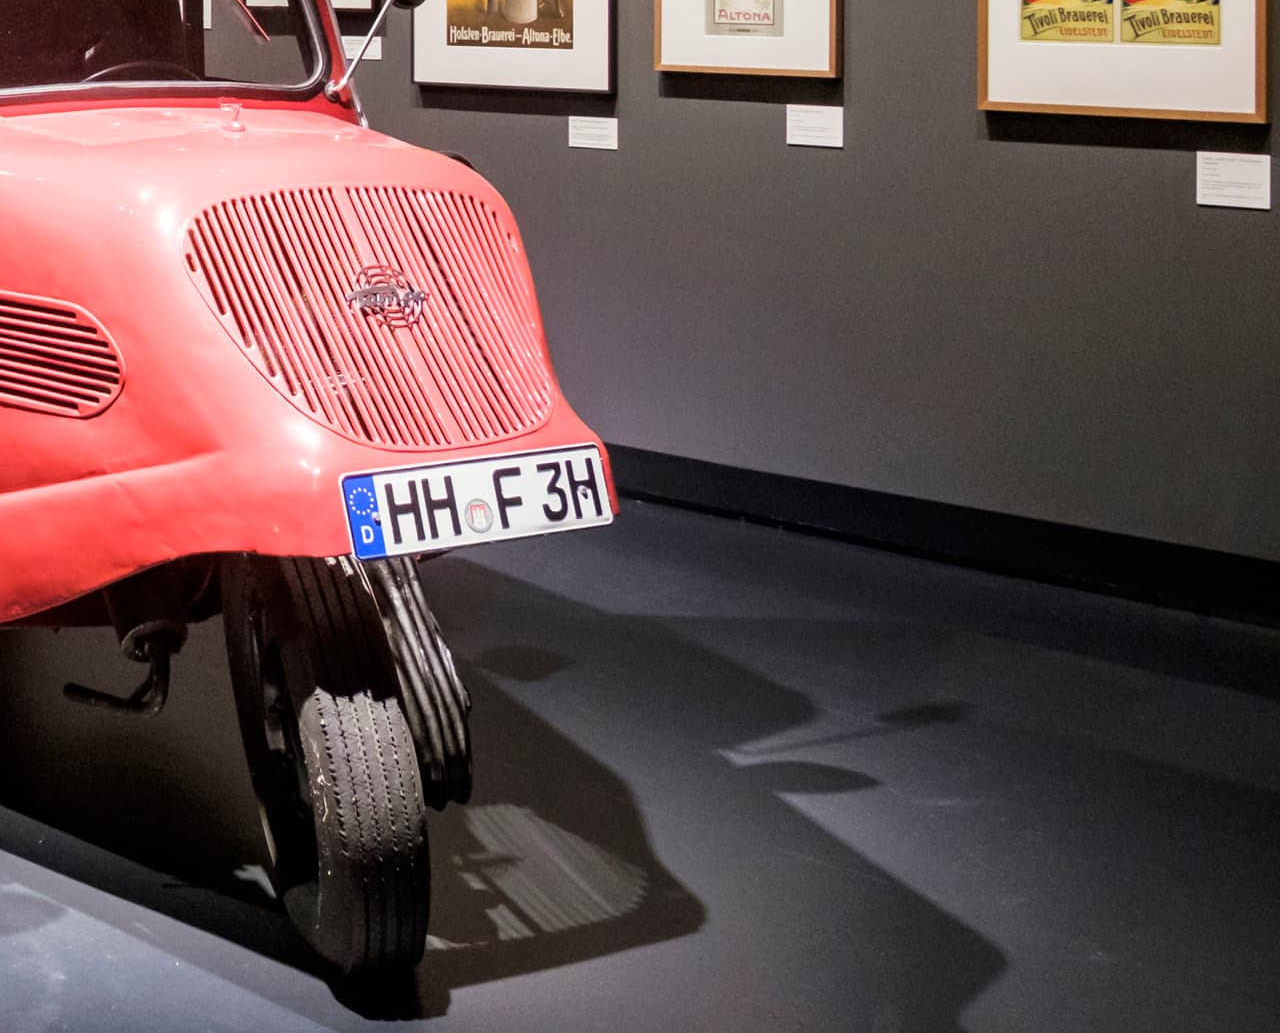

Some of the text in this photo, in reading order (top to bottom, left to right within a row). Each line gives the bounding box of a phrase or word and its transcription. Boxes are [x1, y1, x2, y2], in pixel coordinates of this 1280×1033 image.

[718, 9, 770, 22] ALTONA
[1024, 7, 1109, 36] Tivoli Brauerei
[1124, 8, 1215, 39] Tivoli Brauerei
[384, 457, 603, 544] HH F 3H
[361, 525, 374, 544] D
